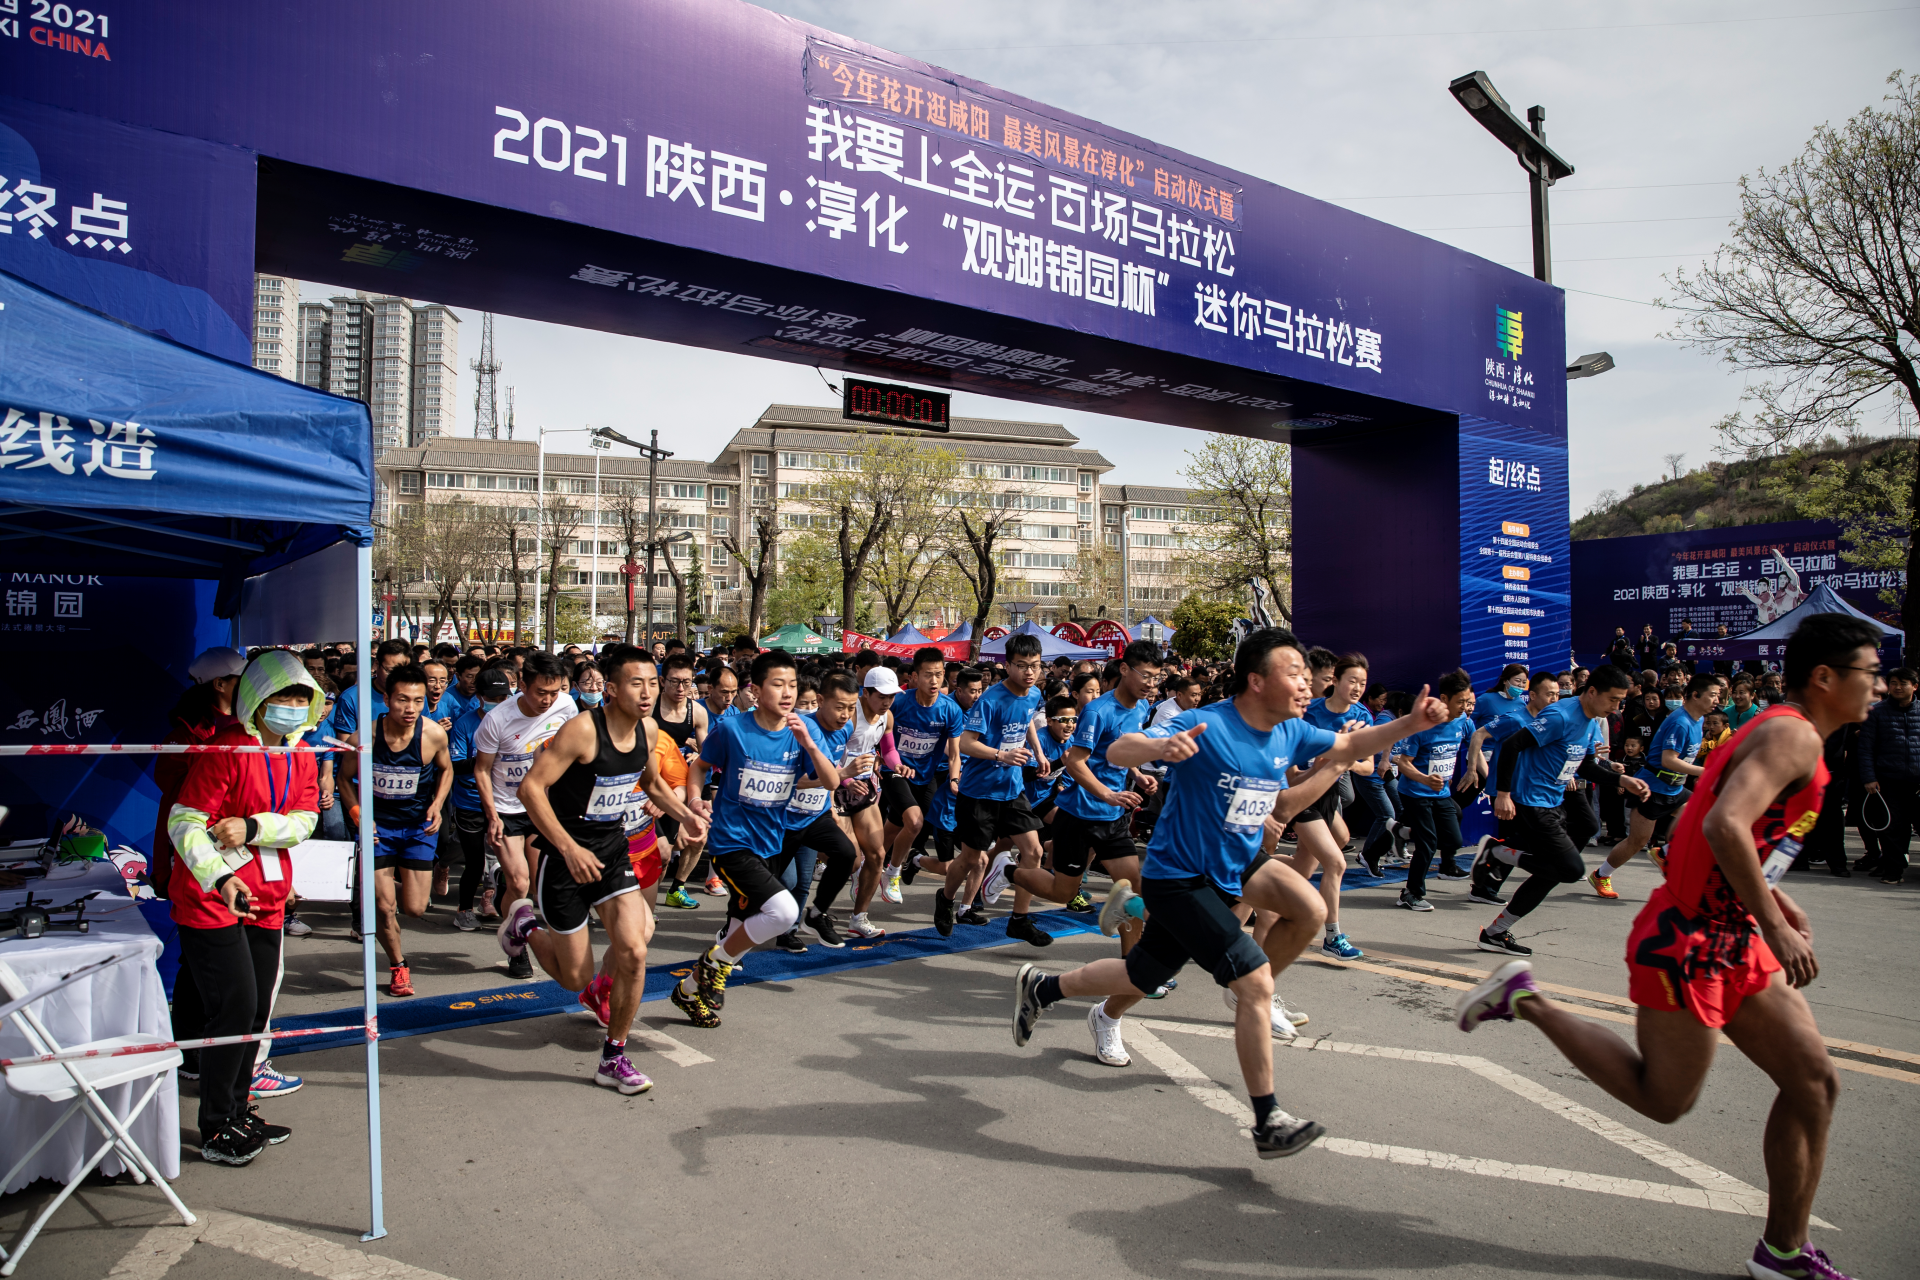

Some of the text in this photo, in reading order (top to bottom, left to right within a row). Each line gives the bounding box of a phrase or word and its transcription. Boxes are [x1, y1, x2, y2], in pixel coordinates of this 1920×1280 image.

[30, 0, 108, 38] 2021
[30, 26, 111, 61] CHINA
[1153, 167, 1235, 222] 启动仪式暨
[494, 105, 1382, 373] 2021 陕西·淳化 “观湖锦园杯” 迷你马拉松赛
[569, 263, 867, 331] 迷你马拉松赛
[1485, 378, 1535, 399] CHUNHUA OF SHAANXI
[1488, 456, 1541, 492] 起/终点
[11, 572, 104, 586] MANOR
[1672, 561, 1740, 581] 我要上全运
[6, 589, 83, 618] 锦园
[1613, 588, 1640, 601] 2021
[1641, 583, 1706, 600] 陕西·淳化
[745, 777, 790, 794] A0087
